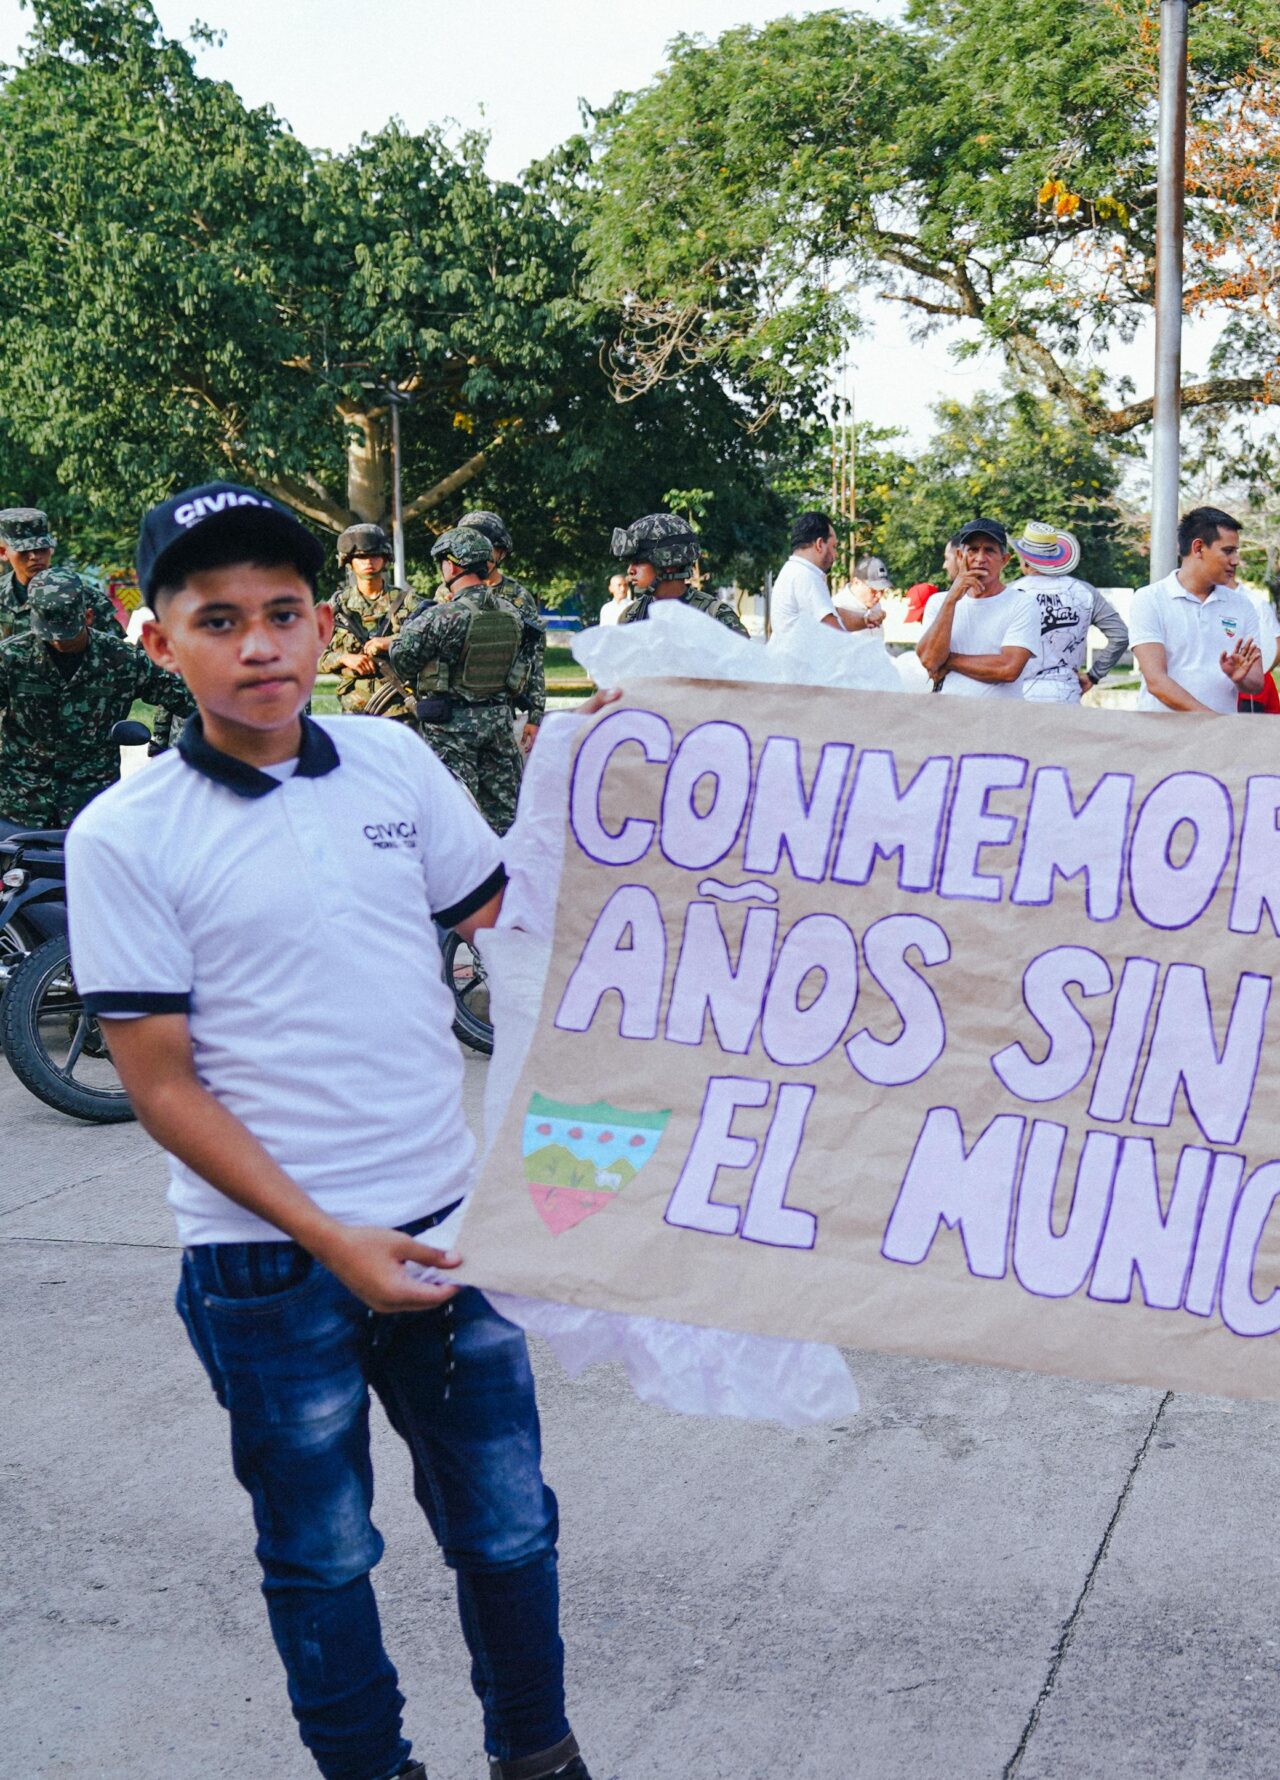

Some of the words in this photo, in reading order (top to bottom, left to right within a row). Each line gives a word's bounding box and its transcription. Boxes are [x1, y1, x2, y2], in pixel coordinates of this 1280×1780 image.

[174, 491, 273, 525] CIVI
[553, 877, 951, 1087] AÑOS
[990, 944, 1273, 1145] SIN
[663, 1074, 818, 1250] EL
